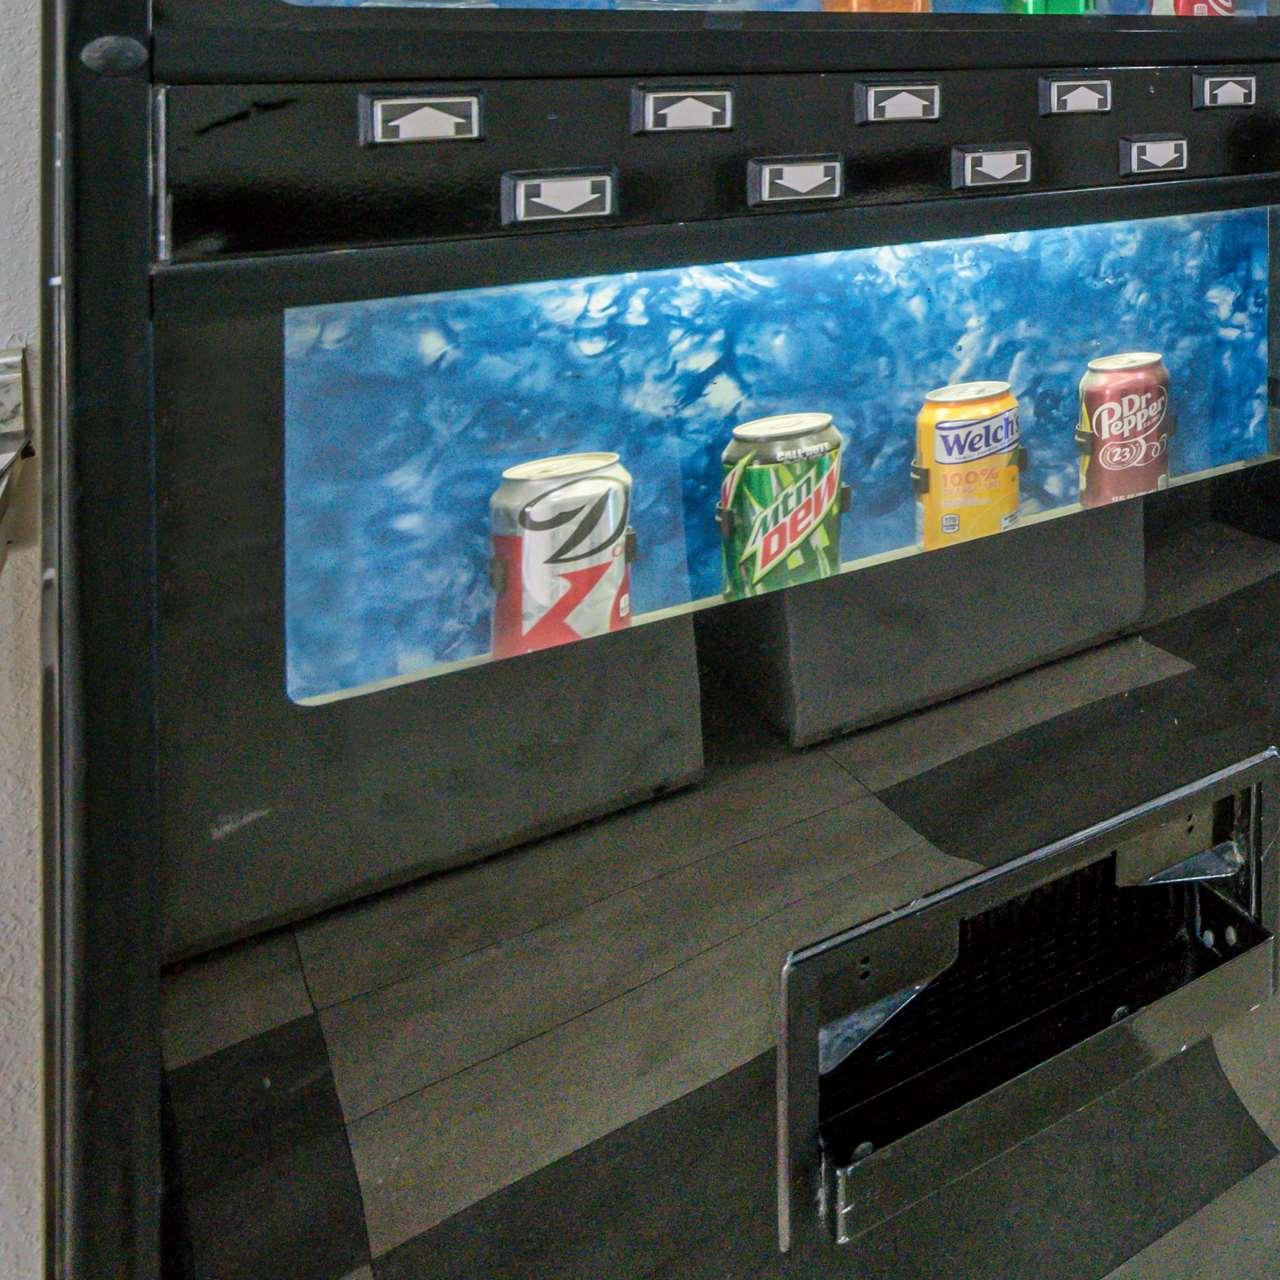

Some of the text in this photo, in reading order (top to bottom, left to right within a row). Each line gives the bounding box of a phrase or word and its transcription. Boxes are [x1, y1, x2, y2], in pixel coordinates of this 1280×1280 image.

[1121, 392, 1152, 417] Dr
[1093, 396, 1165, 440] Pepper
[1112, 447, 1130, 462] 23
[942, 467, 999, 487] 100%
